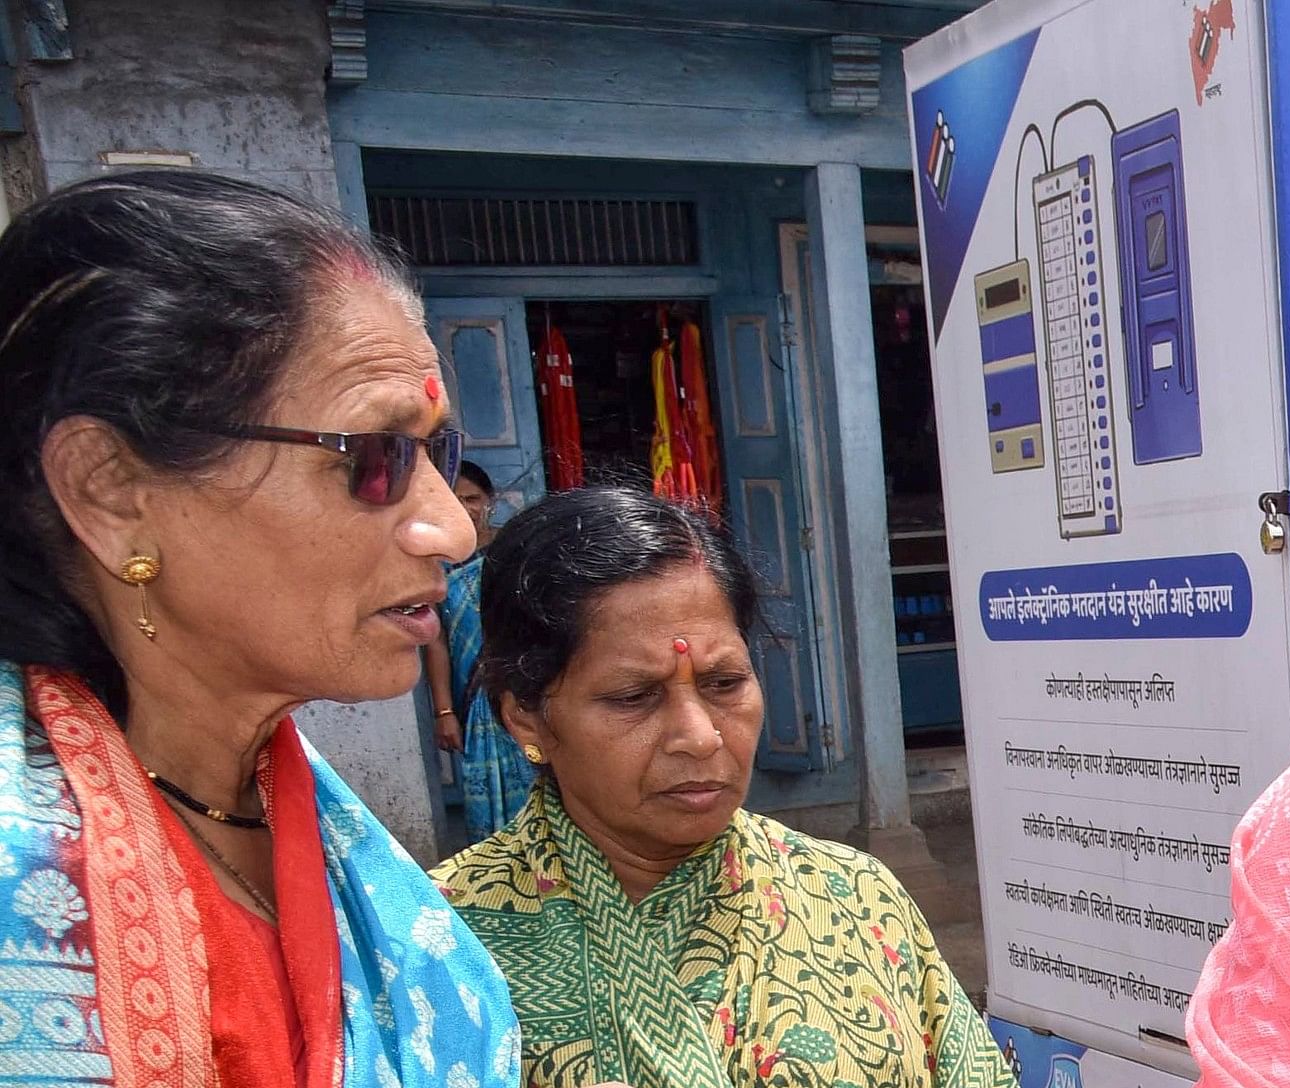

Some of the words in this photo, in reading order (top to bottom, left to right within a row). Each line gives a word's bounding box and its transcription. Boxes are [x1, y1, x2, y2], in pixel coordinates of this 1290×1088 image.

[988, 587, 1016, 621] आपले
[1016, 585, 1070, 625] इलेक्ट्रॉनिक
[1070, 592, 1106, 620] मतदान
[1107, 582, 1126, 616] यंत्र
[1126, 578, 1168, 627] सुरक्षीत
[1169, 577, 1194, 617] आहे
[1195, 585, 1233, 613] कारण
[1045, 672, 1085, 702] कोणत्याही
[1143, 673, 1175, 703] अलिप्त
[1004, 741, 1045, 769] विनापरवाना
[1046, 745, 1083, 779] अनधिकृत
[1083, 753, 1102, 774] वापर
[1103, 749, 1163, 781] ओळखण्याच्या
[1022, 812, 1056, 840] सांकेतिक
[1068, 889, 1090, 918] आणि
[1143, 904, 1206, 942] ओळखण्याच्या
[1119, 972, 1162, 1007] माहितीच्या
